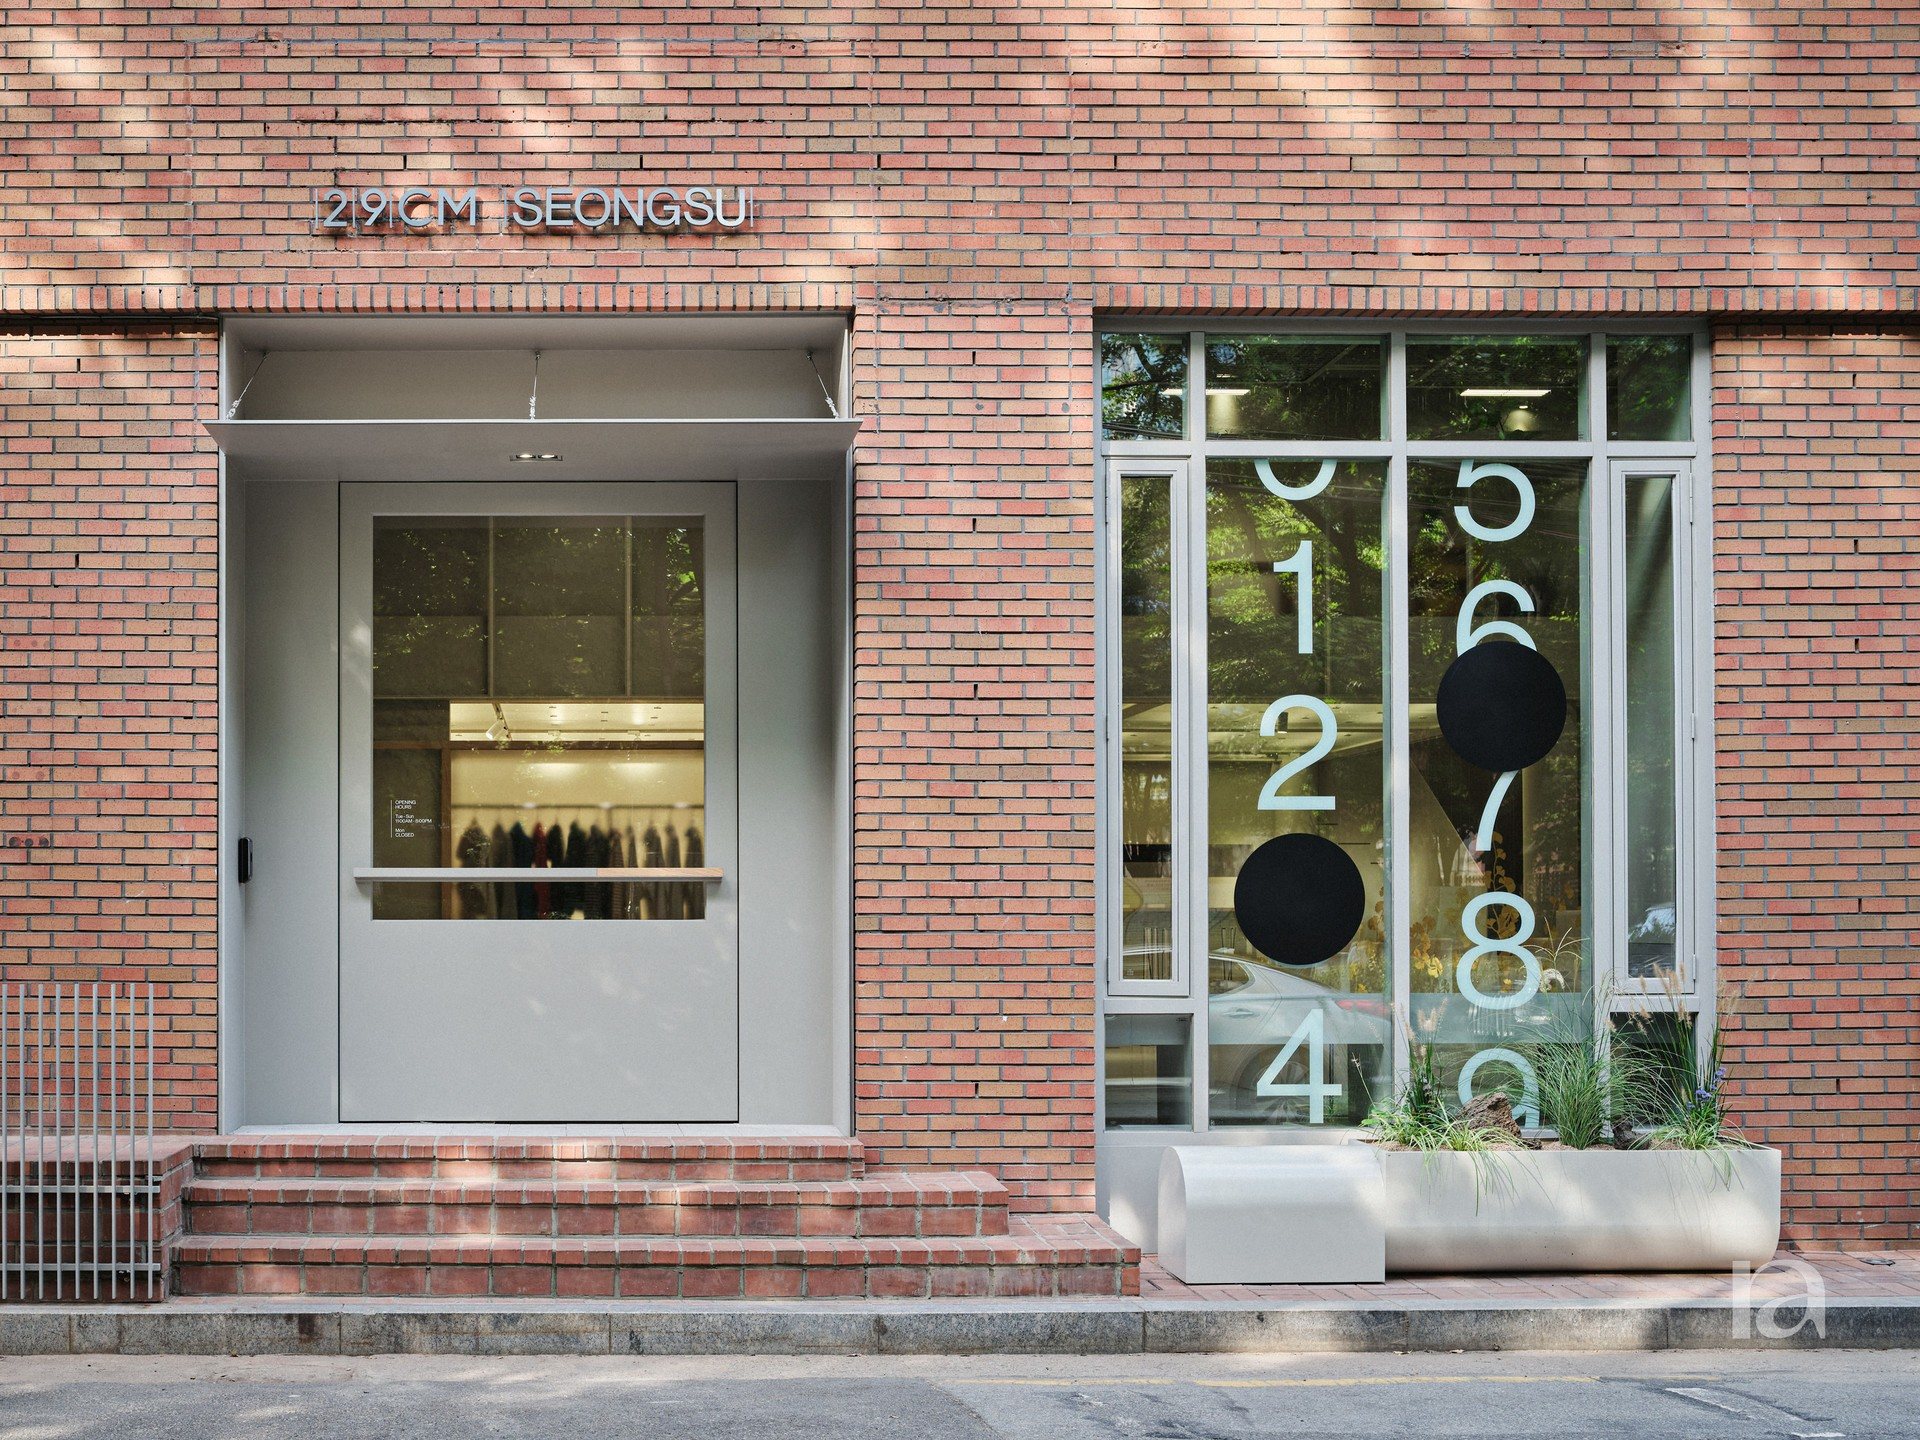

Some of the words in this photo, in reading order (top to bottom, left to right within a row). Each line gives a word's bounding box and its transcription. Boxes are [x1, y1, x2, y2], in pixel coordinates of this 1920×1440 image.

[512, 187, 747, 227] SEONGSU
[1454, 459, 1536, 542] 5
[1272, 540, 1313, 654] 1
[1257, 694, 1338, 810] 2
[1456, 891, 1541, 1010] 8
[1256, 1008, 1343, 1124] 4
